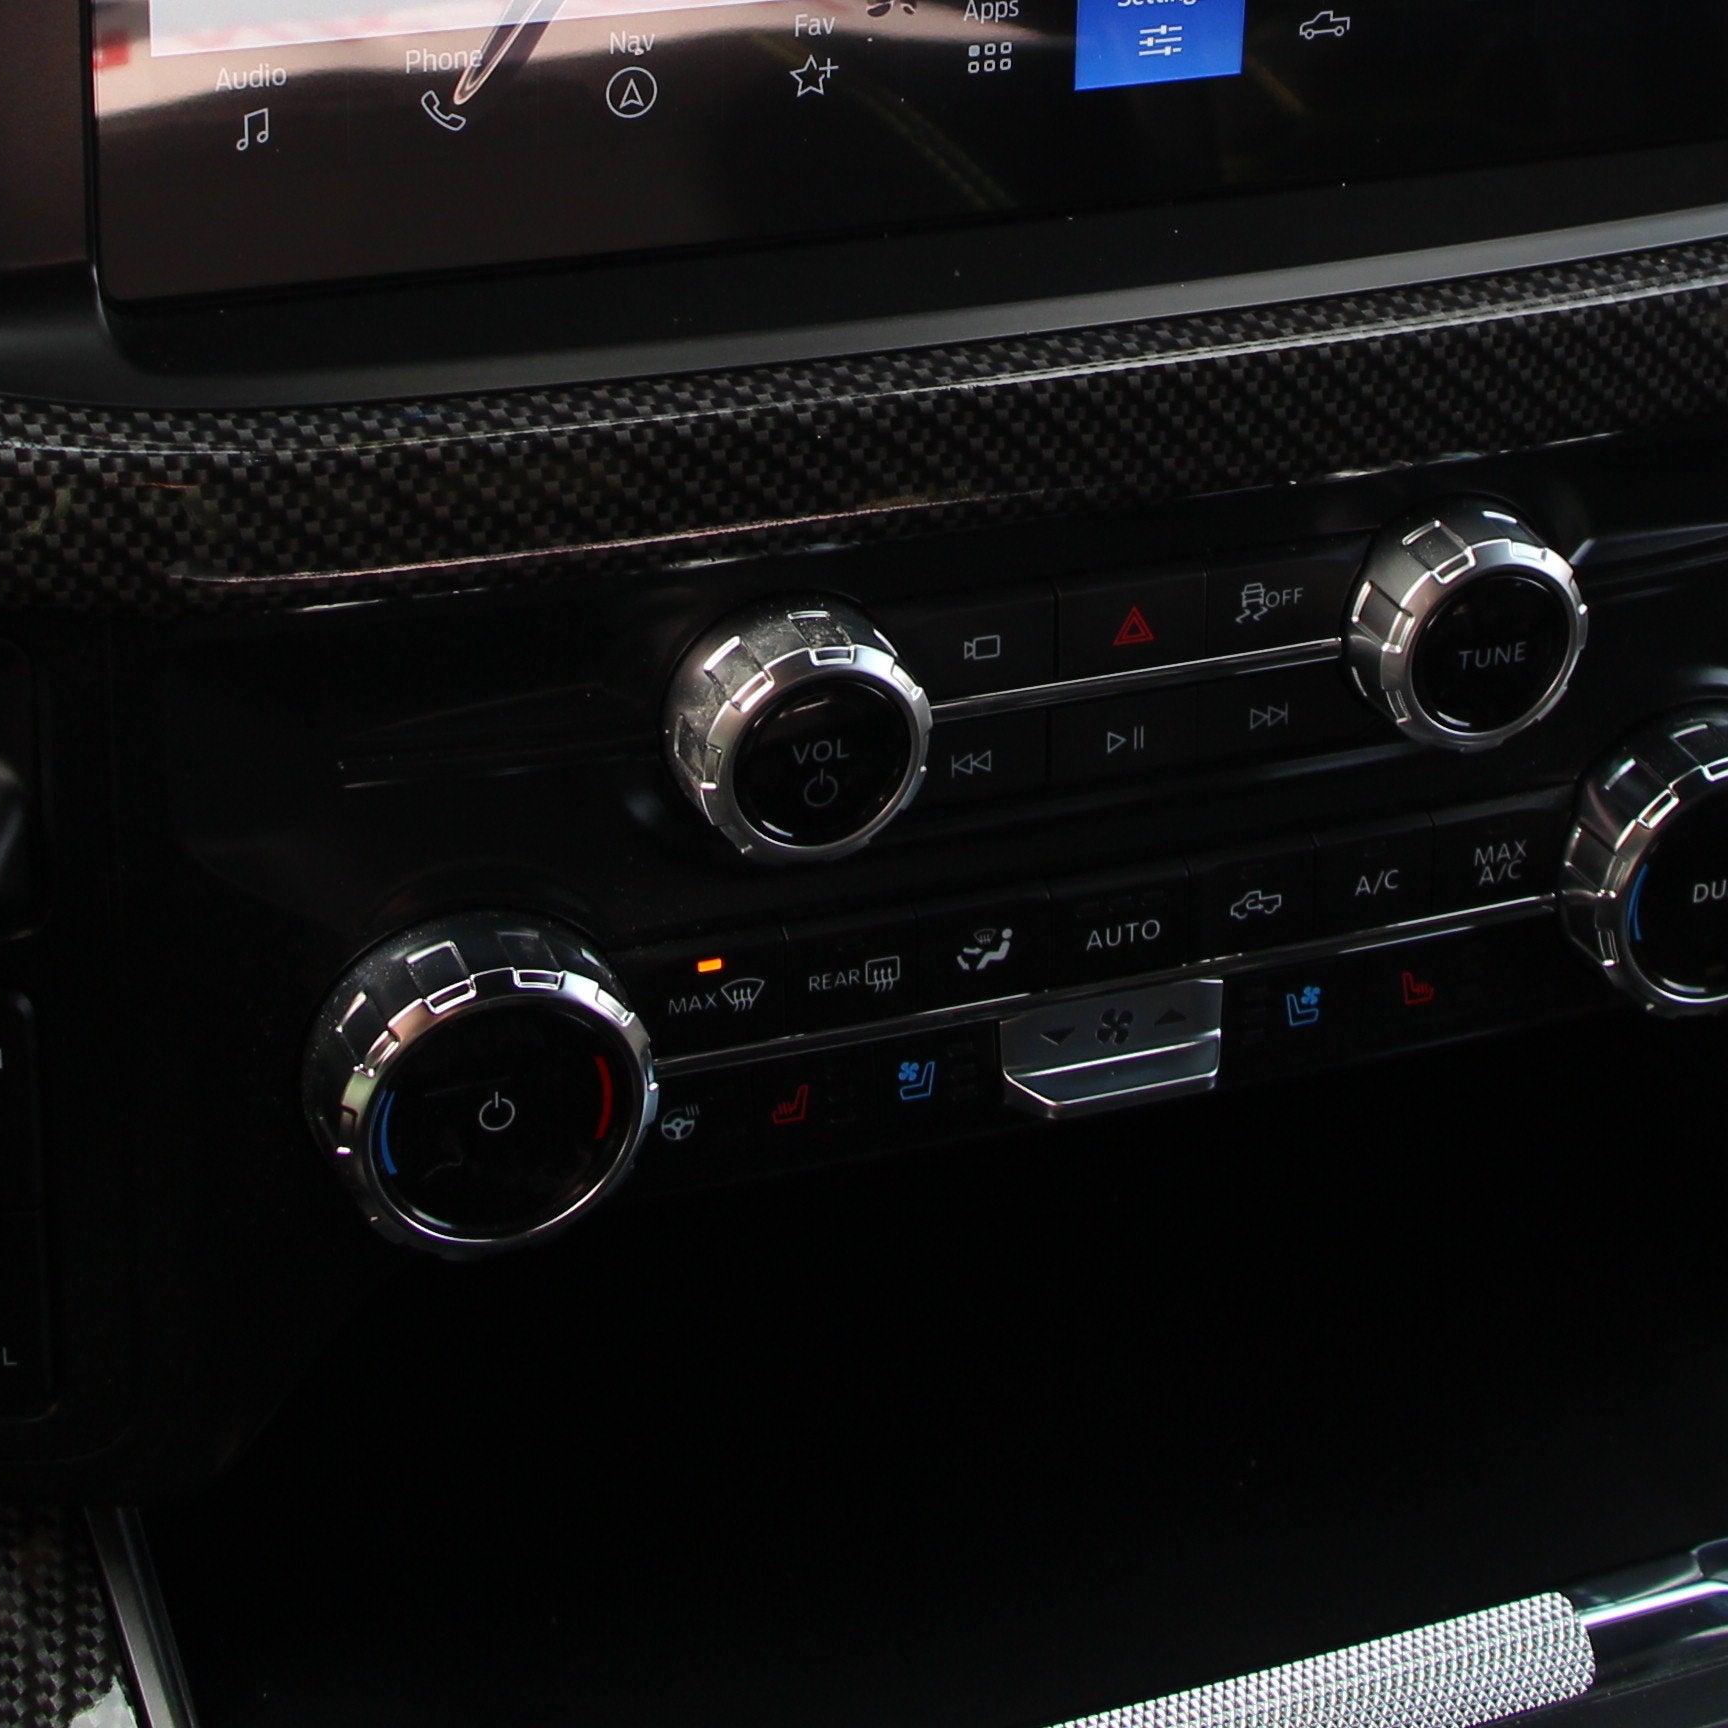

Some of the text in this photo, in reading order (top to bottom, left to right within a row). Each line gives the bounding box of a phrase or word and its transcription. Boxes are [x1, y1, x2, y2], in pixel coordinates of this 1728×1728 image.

[794, 13, 836, 36] Fav
[610, 30, 654, 55] Nav
[405, 49, 483, 73] Phone
[215, 65, 287, 90] Audio
[1265, 585, 1305, 610] OFF
[1458, 641, 1527, 671] TUNE
[791, 736, 851, 765] VOL
[1474, 838, 1529, 868] MAX
[1355, 868, 1400, 894] A/C
[1478, 858, 1522, 886] A/C
[1085, 918, 1161, 952] AUTO
[808, 969, 861, 991] REAR
[668, 990, 719, 1015] MAX
